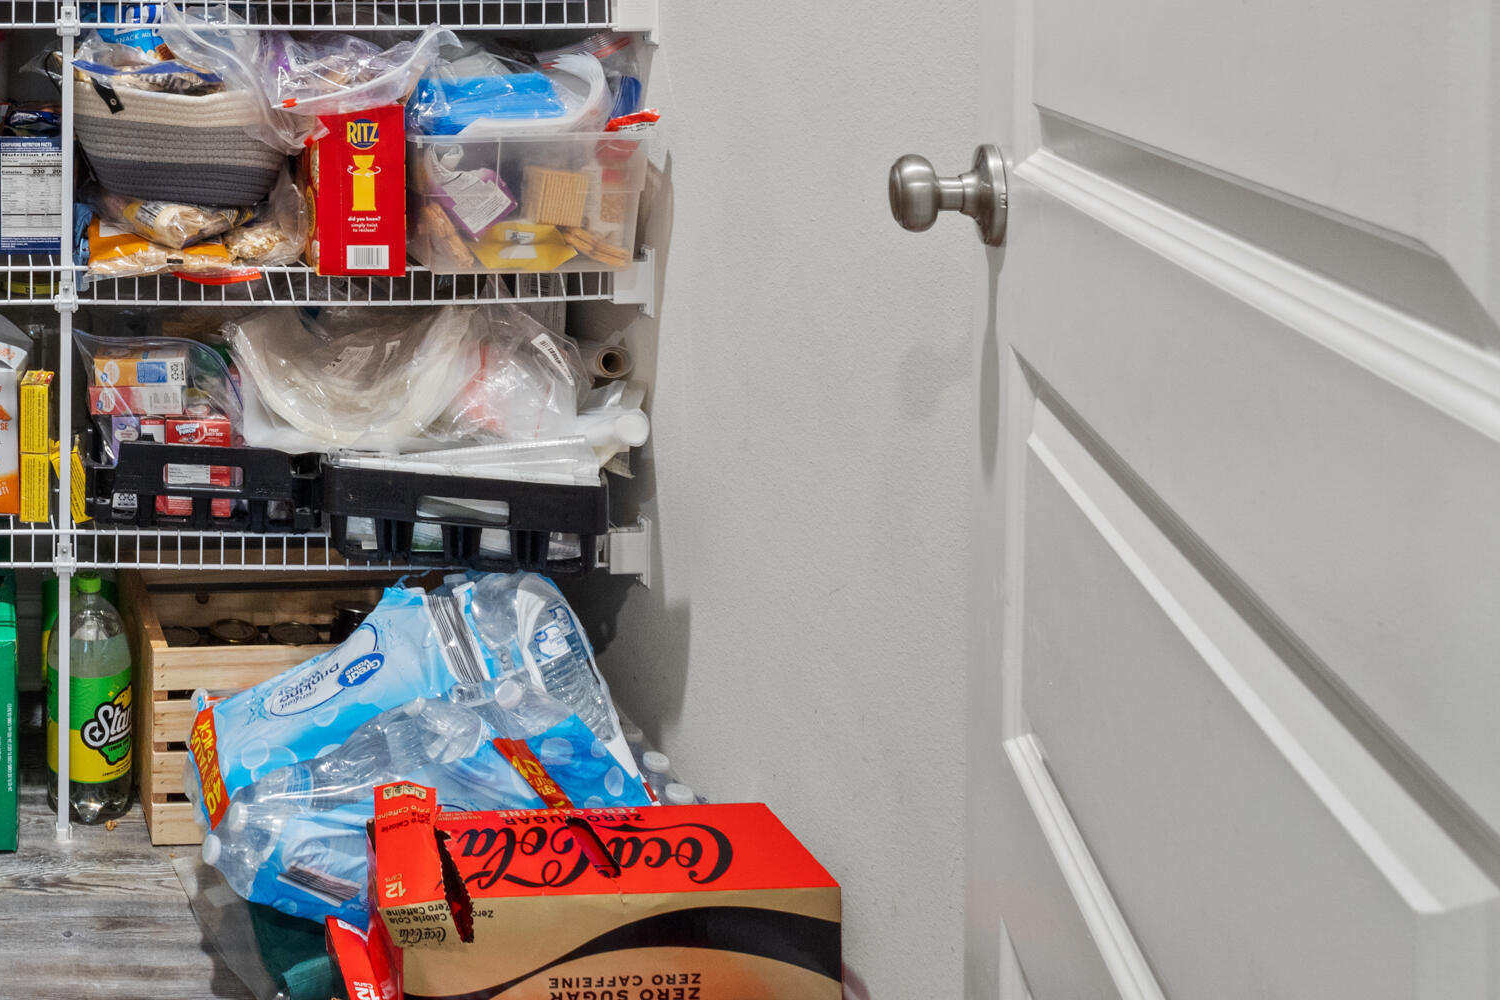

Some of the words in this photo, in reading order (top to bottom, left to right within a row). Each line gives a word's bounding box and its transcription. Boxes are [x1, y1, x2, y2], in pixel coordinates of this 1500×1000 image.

[347, 121, 380, 145] RITZ
[344, 659, 369, 678] Value
[348, 657, 382, 684] Great
[279, 661, 341, 704] Drinking
[205, 779, 221, 815] 40
[376, 810, 410, 821] Caffeine
[593, 813, 643, 825] ZERO
[437, 820, 733, 890] CocaCola
[384, 873, 403, 883] Cans
[385, 881, 406, 899] 12
[385, 906, 426, 918] Caffeine
[412, 912, 448, 922] Calorie
[388, 916, 411, 925] Cola
[548, 975, 643, 989] CAFFEINE
[651, 973, 701, 986] ZERO
